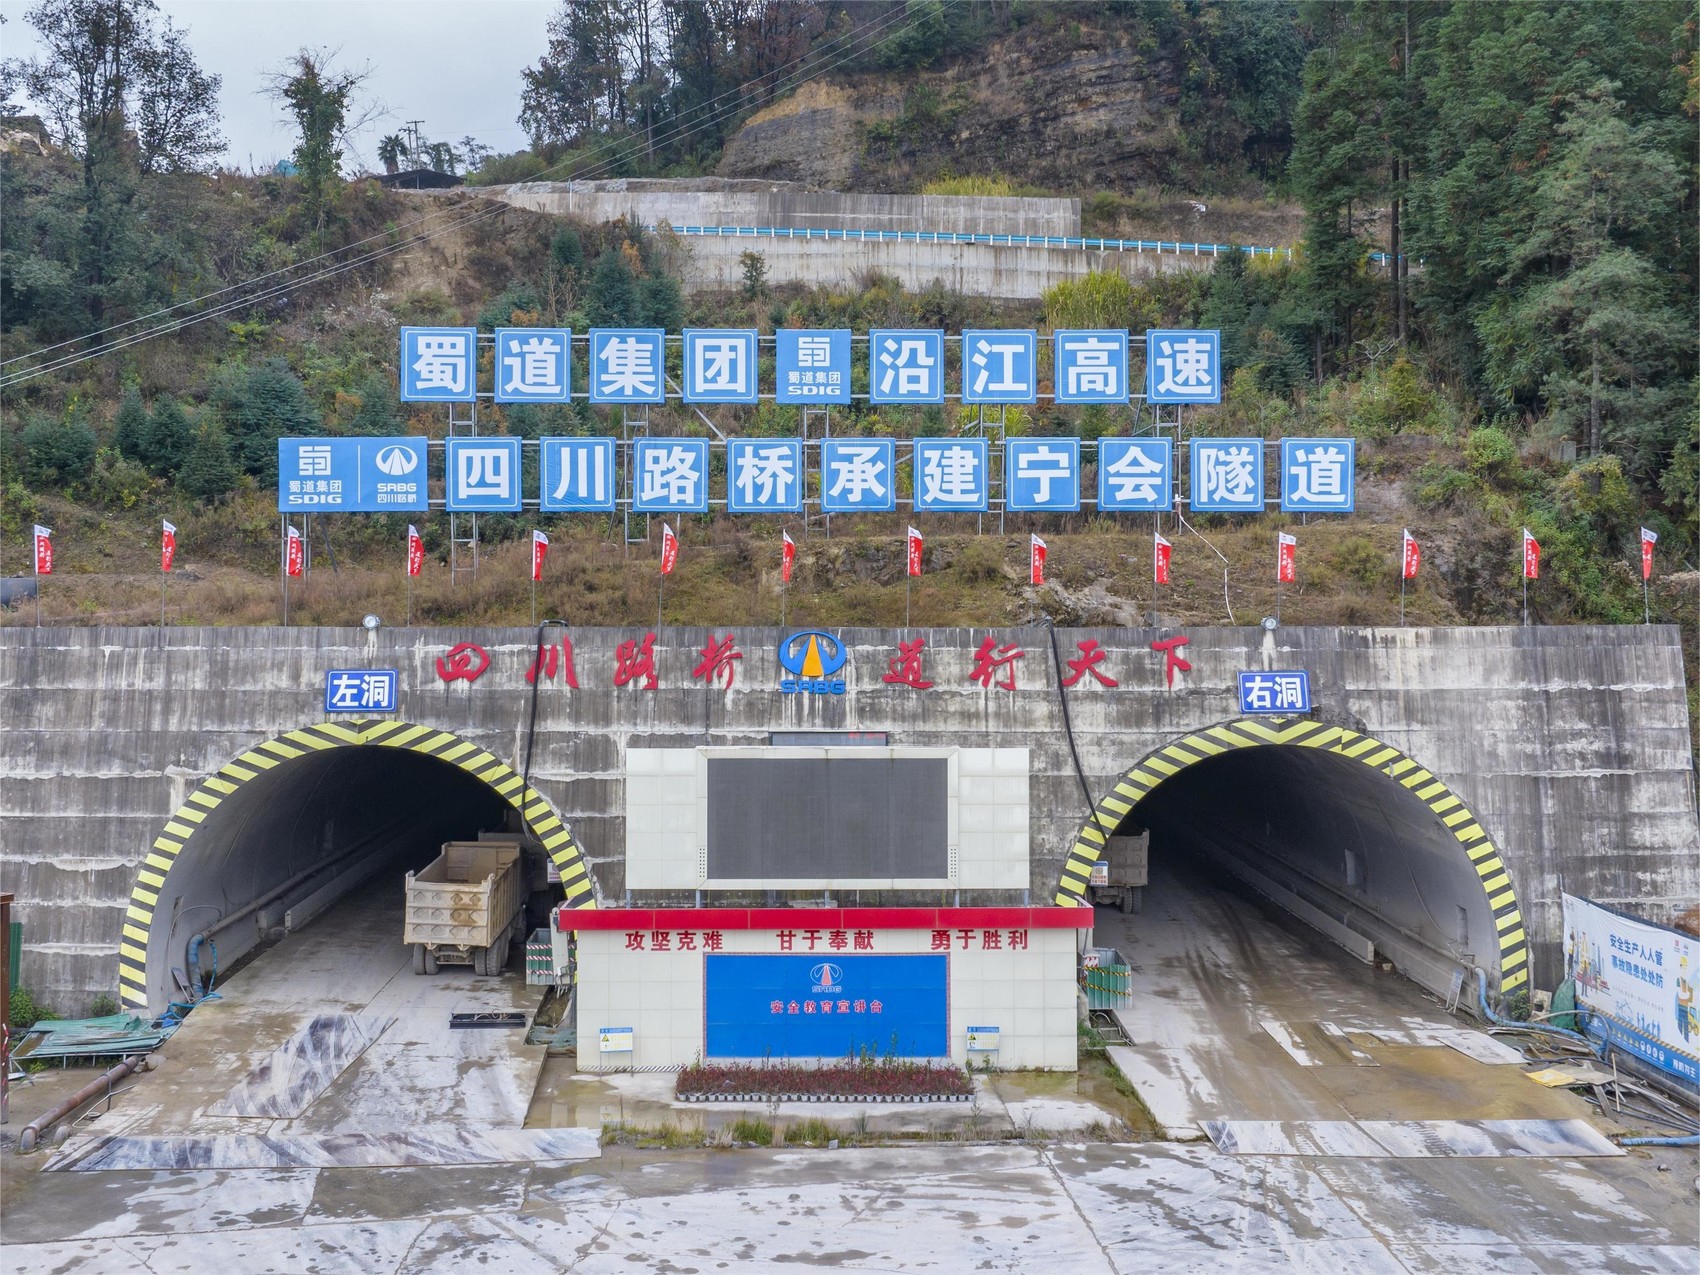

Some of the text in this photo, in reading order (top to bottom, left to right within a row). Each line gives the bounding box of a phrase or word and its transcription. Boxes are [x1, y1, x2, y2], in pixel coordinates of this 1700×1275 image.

[413, 334, 1212, 395] 蜀道集团 沿江高速
[788, 371, 841, 384] 蜀道集团
[787, 385, 841, 396] SDIG
[457, 446, 1347, 503] 四川路桥承建宁会隧道
[289, 480, 342, 493] 蜀道集团
[377, 483, 417, 492] SABG
[288, 494, 342, 504] SDIG
[377, 493, 417, 503] 四川路桥
[435, 632, 743, 690] 四川路桥
[883, 636, 1192, 691] 道行天下
[332, 675, 393, 709] 左洞
[780, 679, 846, 695] SABG
[1245, 675, 1305, 710] 右洞
[625, 929, 1029, 951] 攻坚克难 甘于奉献 勇于胜利
[1609, 934, 1663, 967] 安全生产人人管
[770, 999, 883, 1014] 安全教育宣讲台
